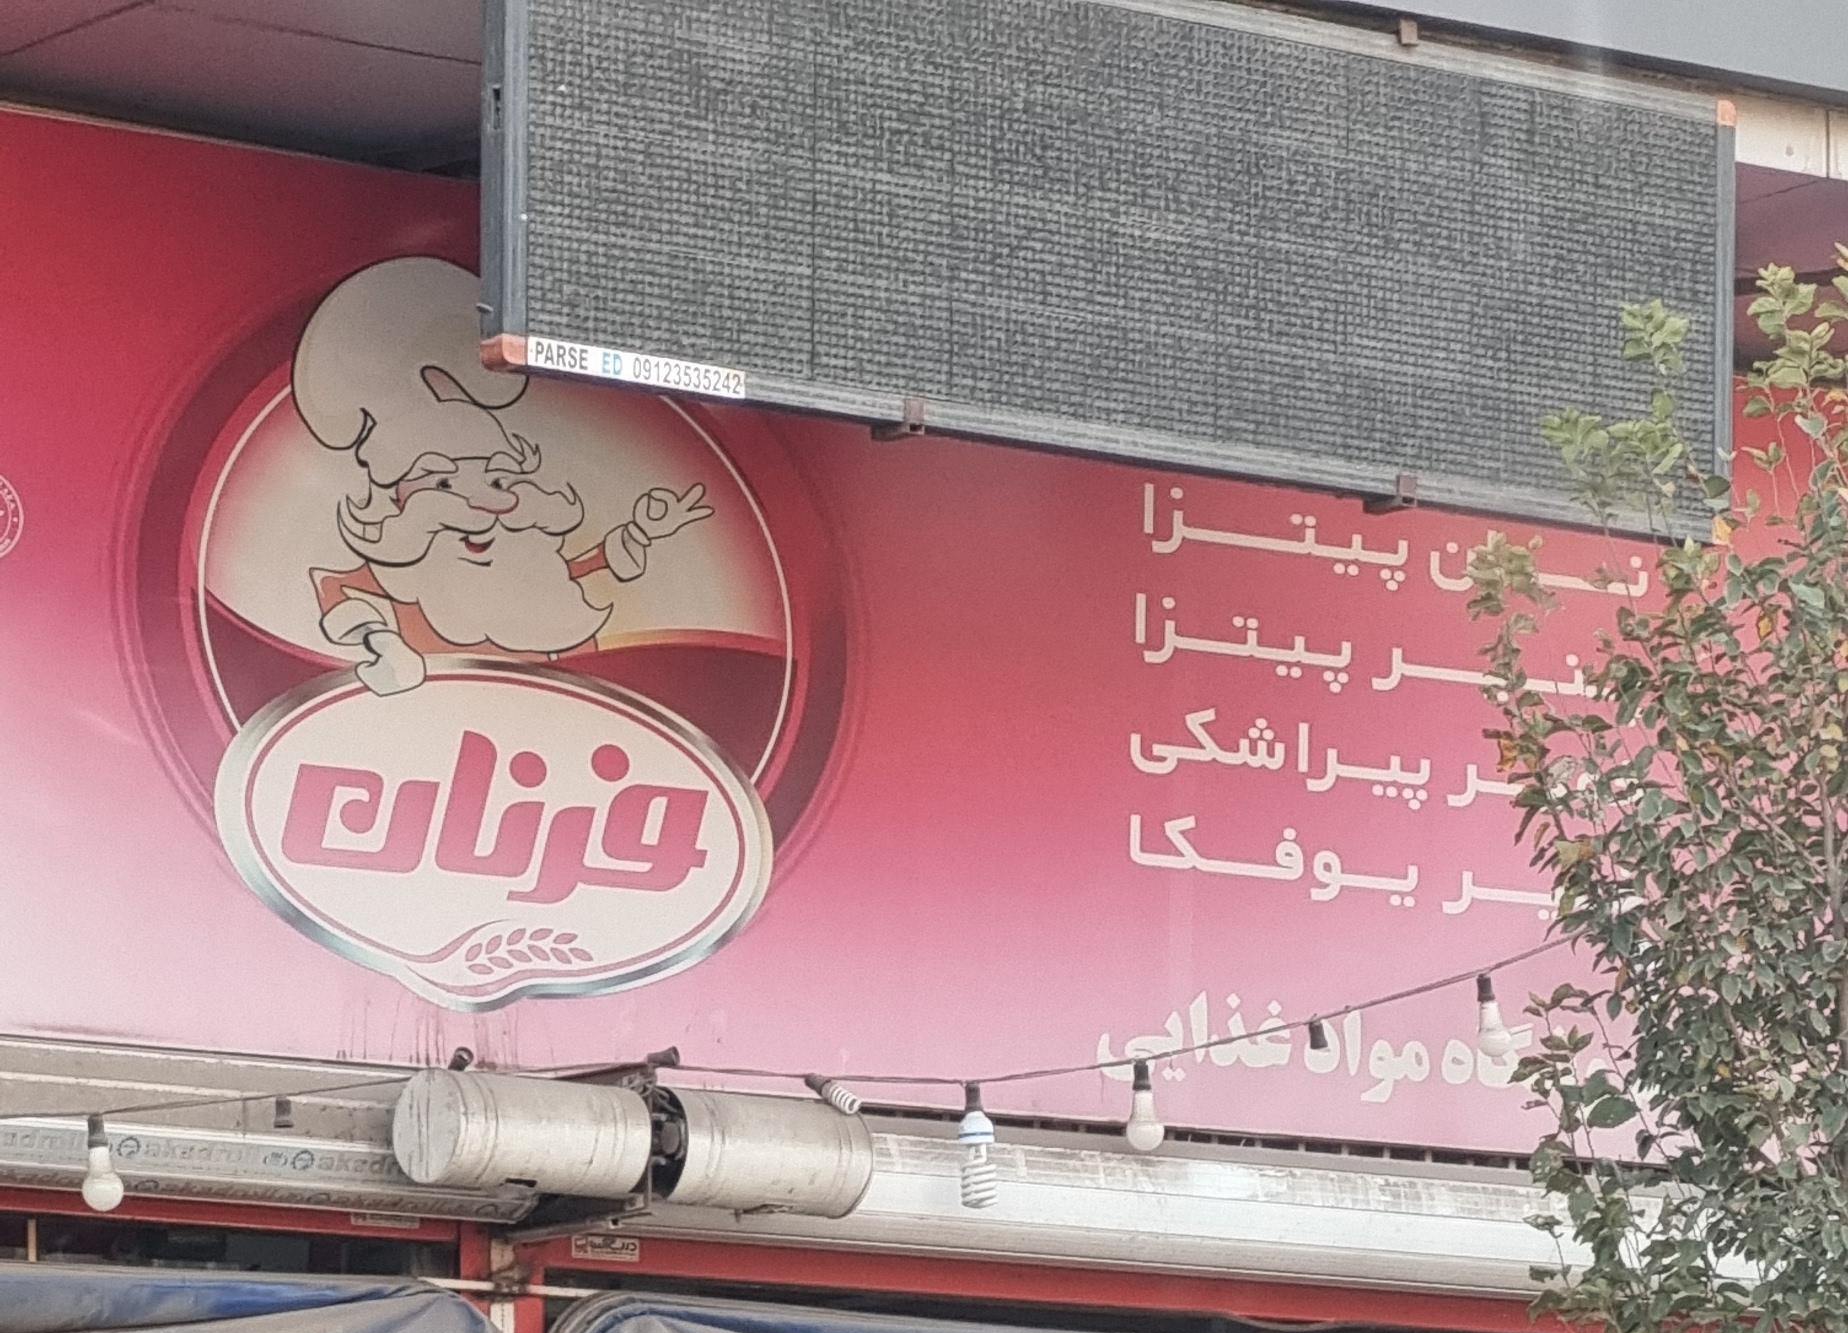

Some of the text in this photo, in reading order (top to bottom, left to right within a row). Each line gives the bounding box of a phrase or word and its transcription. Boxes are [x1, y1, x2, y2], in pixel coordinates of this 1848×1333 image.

[534, 340, 589, 371] PARSE
[632, 356, 742, 395] 09123535242
[1143, 482, 1649, 598] نن پیتزا
[1134, 592, 1353, 694] پیتزا
[1130, 708, 1433, 810] پیراشکی
[280, 729, 711, 905] فرنان
[1129, 814, 1420, 907] یوفکا
[1098, 990, 1292, 1082] غذایی
